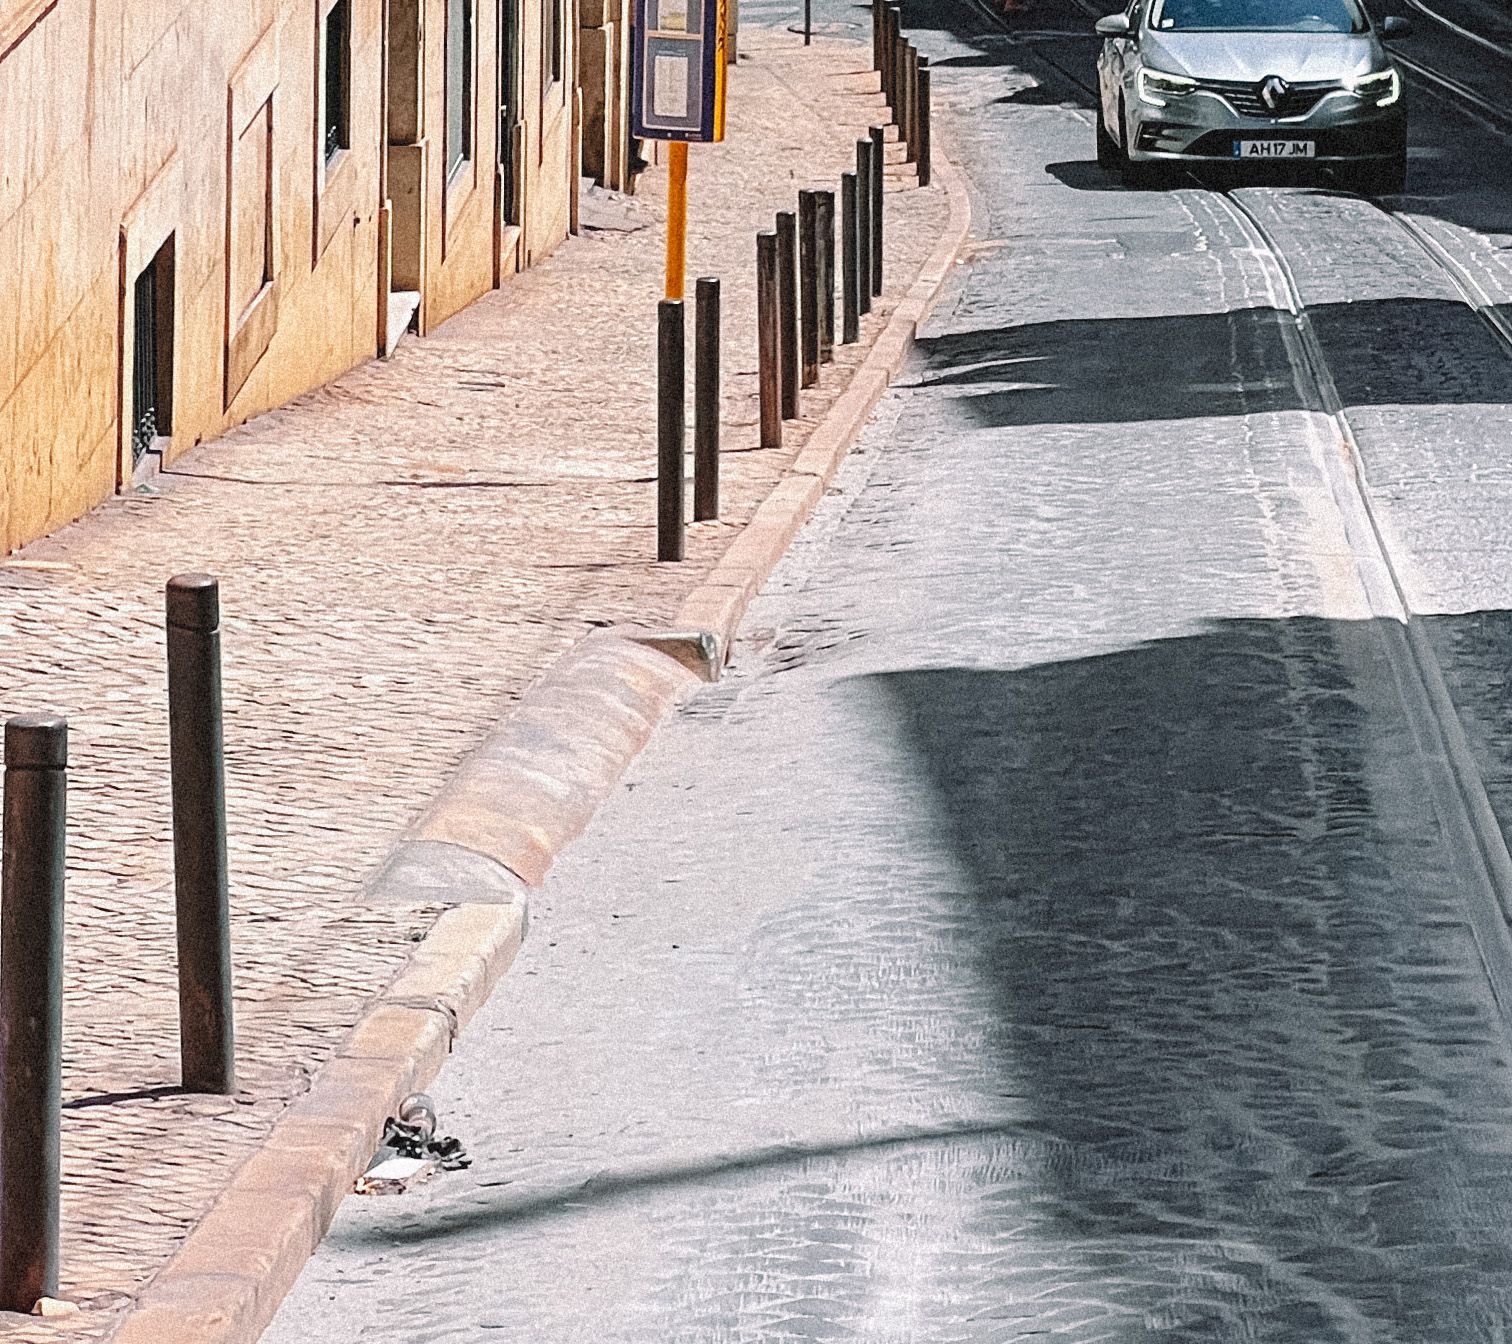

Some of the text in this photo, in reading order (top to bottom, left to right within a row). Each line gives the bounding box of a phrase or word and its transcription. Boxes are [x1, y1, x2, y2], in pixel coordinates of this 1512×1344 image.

[1249, 143, 1308, 155] AH 17 JM
